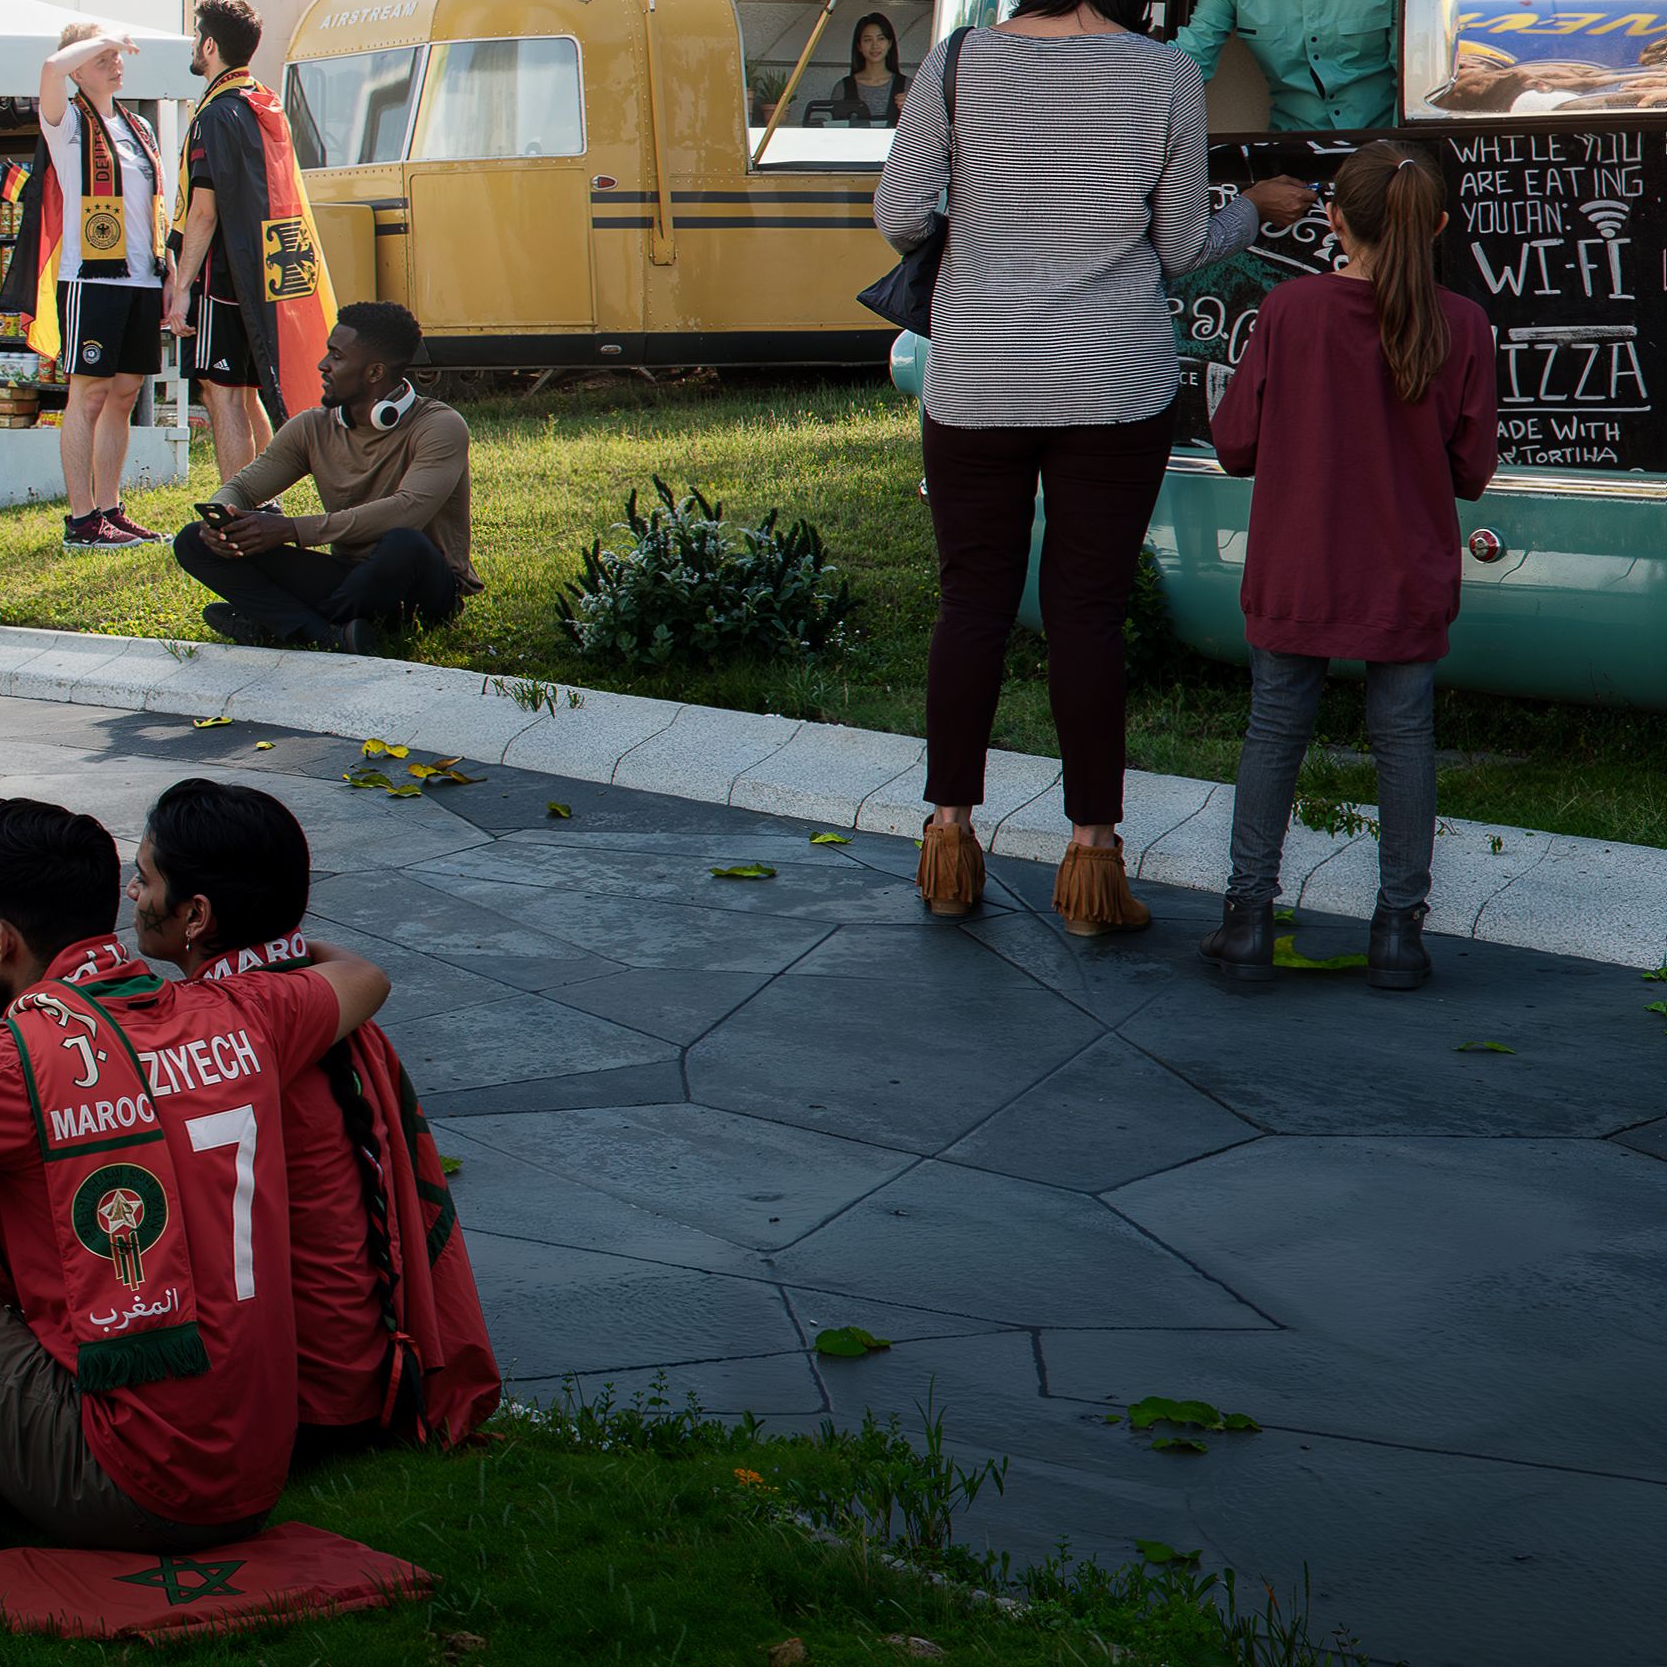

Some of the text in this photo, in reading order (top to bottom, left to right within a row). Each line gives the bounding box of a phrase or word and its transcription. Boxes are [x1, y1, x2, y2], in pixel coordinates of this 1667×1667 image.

[319, 1, 419, 30] AIRSTREAM
[1448, 133, 1566, 163] WHILE
[1460, 171, 1514, 197] ARE
[1471, 238, 1636, 300] WI-FI
[1493, 326, 1648, 402] IZZA
[1550, 415, 1620, 441] WITH
[138, 1029, 261, 1097] ZIYECH
[50, 1092, 157, 1141] MAROC
[184, 1103, 257, 1302] 7
